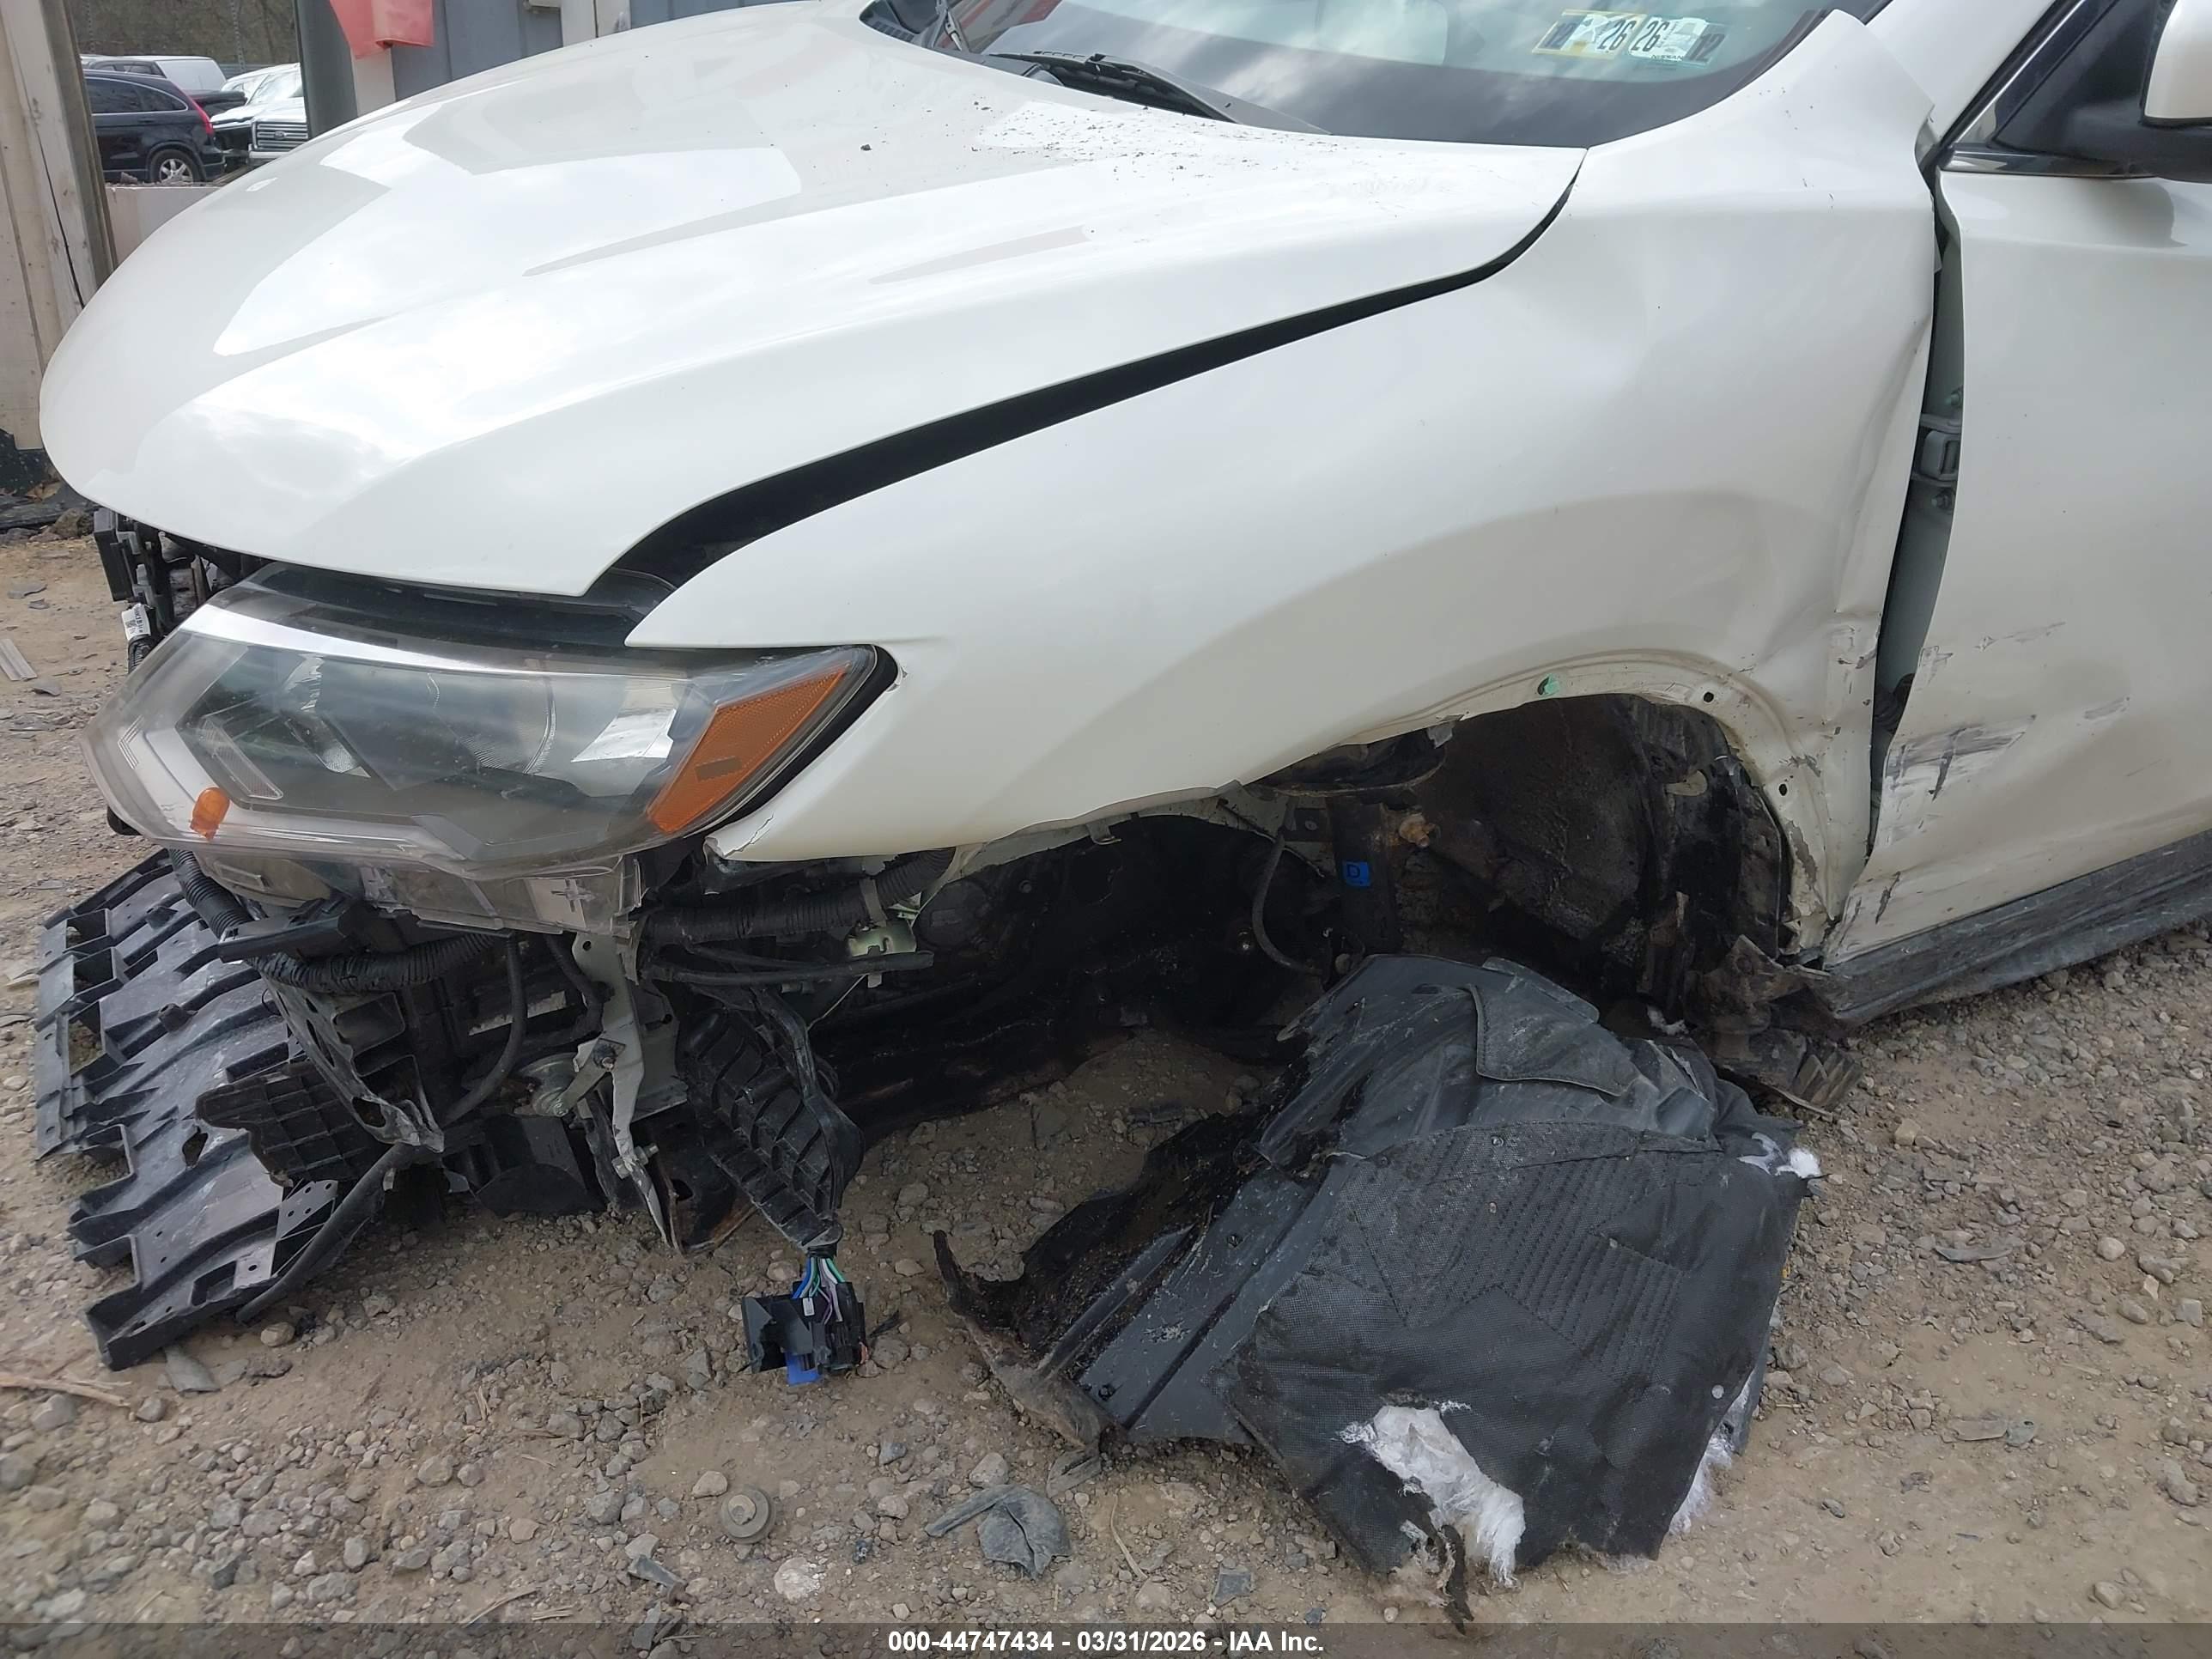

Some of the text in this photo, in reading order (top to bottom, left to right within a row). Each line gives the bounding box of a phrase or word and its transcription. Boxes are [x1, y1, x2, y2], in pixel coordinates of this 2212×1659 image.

[1597, 19, 1636, 51] 26
[1631, 20, 1669, 52] 26
[1688, 33, 1725, 61] 12
